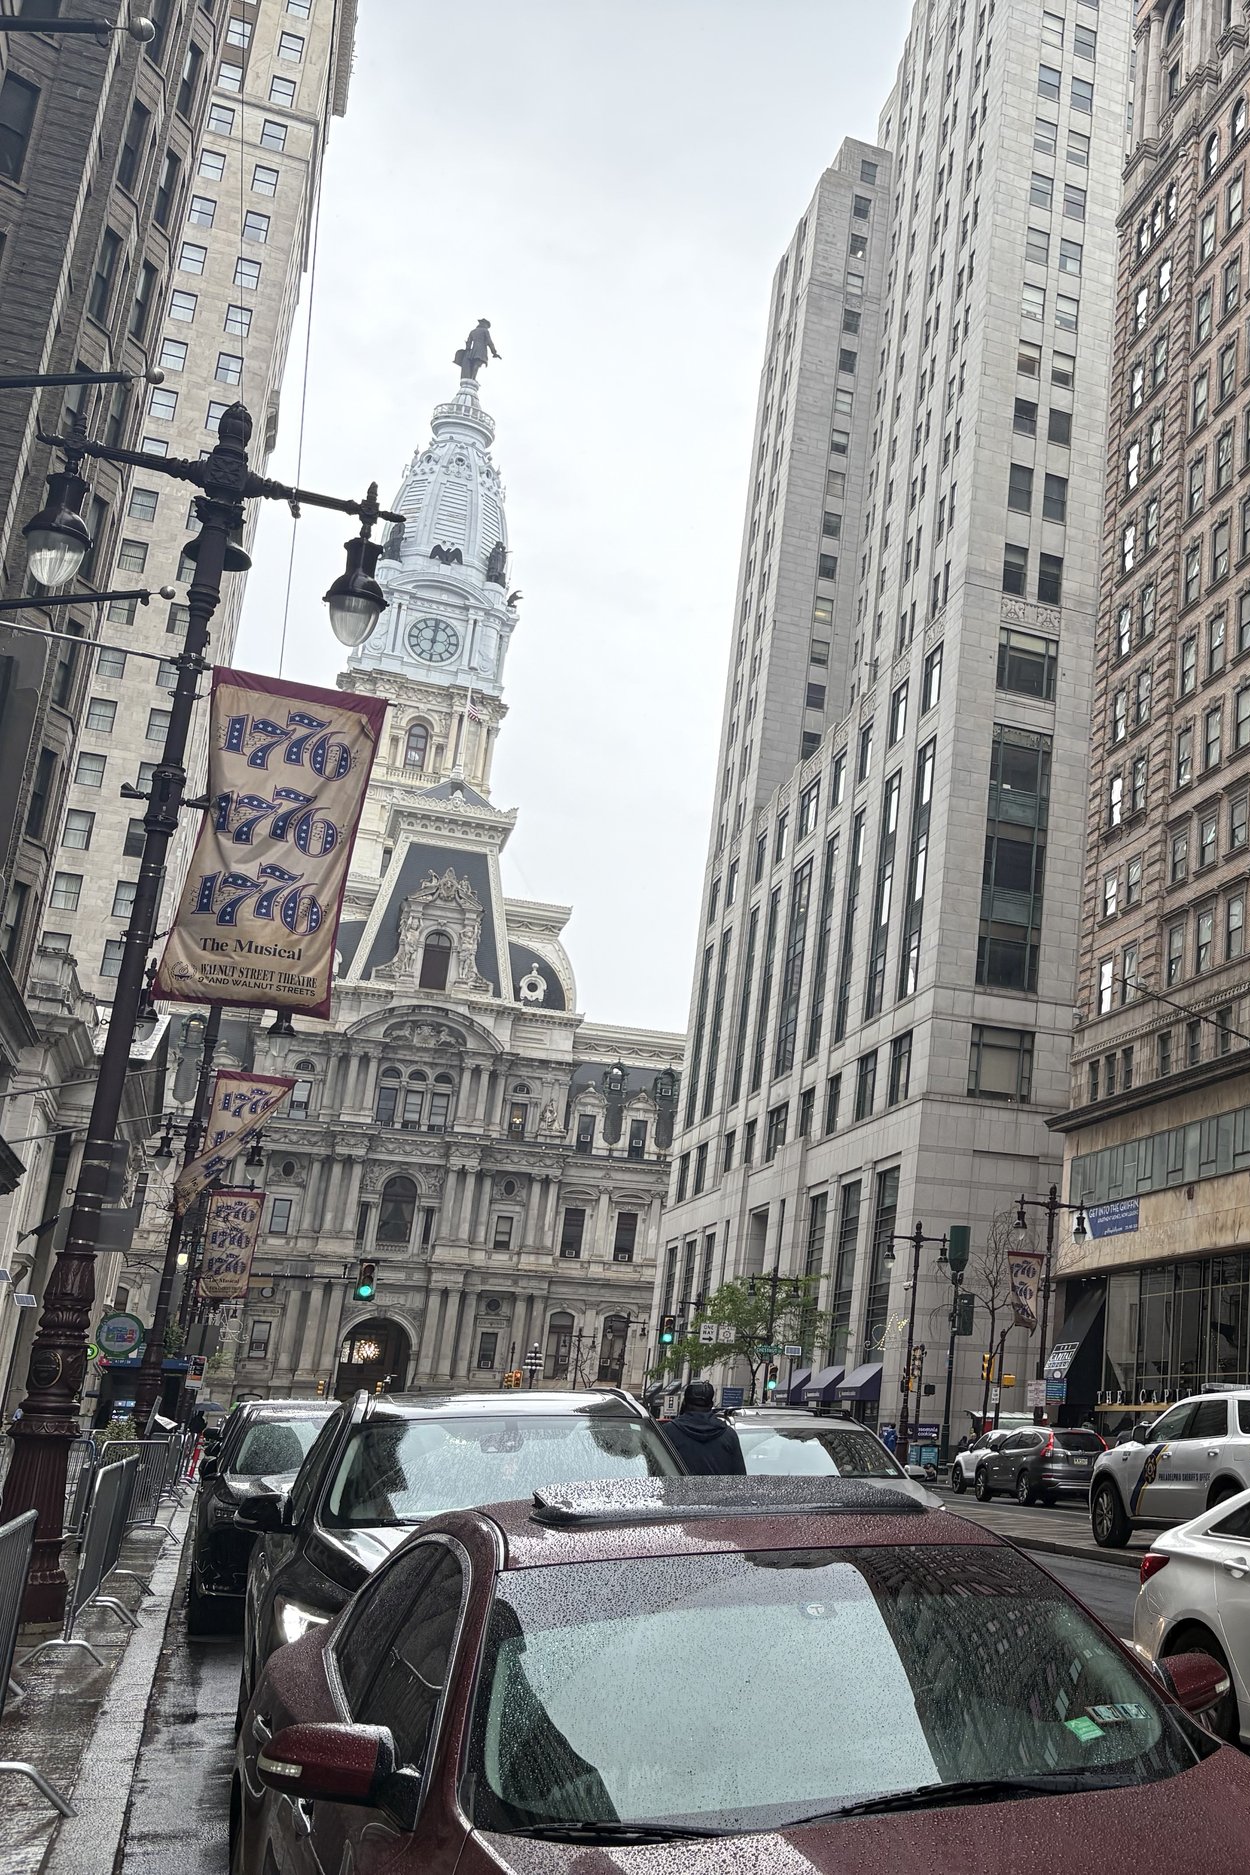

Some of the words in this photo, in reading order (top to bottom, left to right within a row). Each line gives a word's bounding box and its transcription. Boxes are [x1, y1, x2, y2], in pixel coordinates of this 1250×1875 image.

[218, 709, 351, 782] 1776
[214, 785, 338, 858] 1776
[191, 862, 323, 936] 1776
[200, 938, 229, 952] The
[234, 939, 302, 961] Musical
[200, 963, 238, 978] WALNUT
[238, 966, 276, 982] STREET
[277, 971, 318, 989] THEATRE
[231, 979, 275, 990] WALNUT
[275, 984, 316, 997] STREETS
[1089, 1207, 1098, 1218] GET
[1098, 1205, 1110, 1216] INTO
[1110, 1202, 1120, 1213] THE
[1120, 1198, 1139, 1211] GRIFFIN
[1096, 1390, 1123, 1404] THE
[1139, 1389, 1206, 1403] CAPIT
